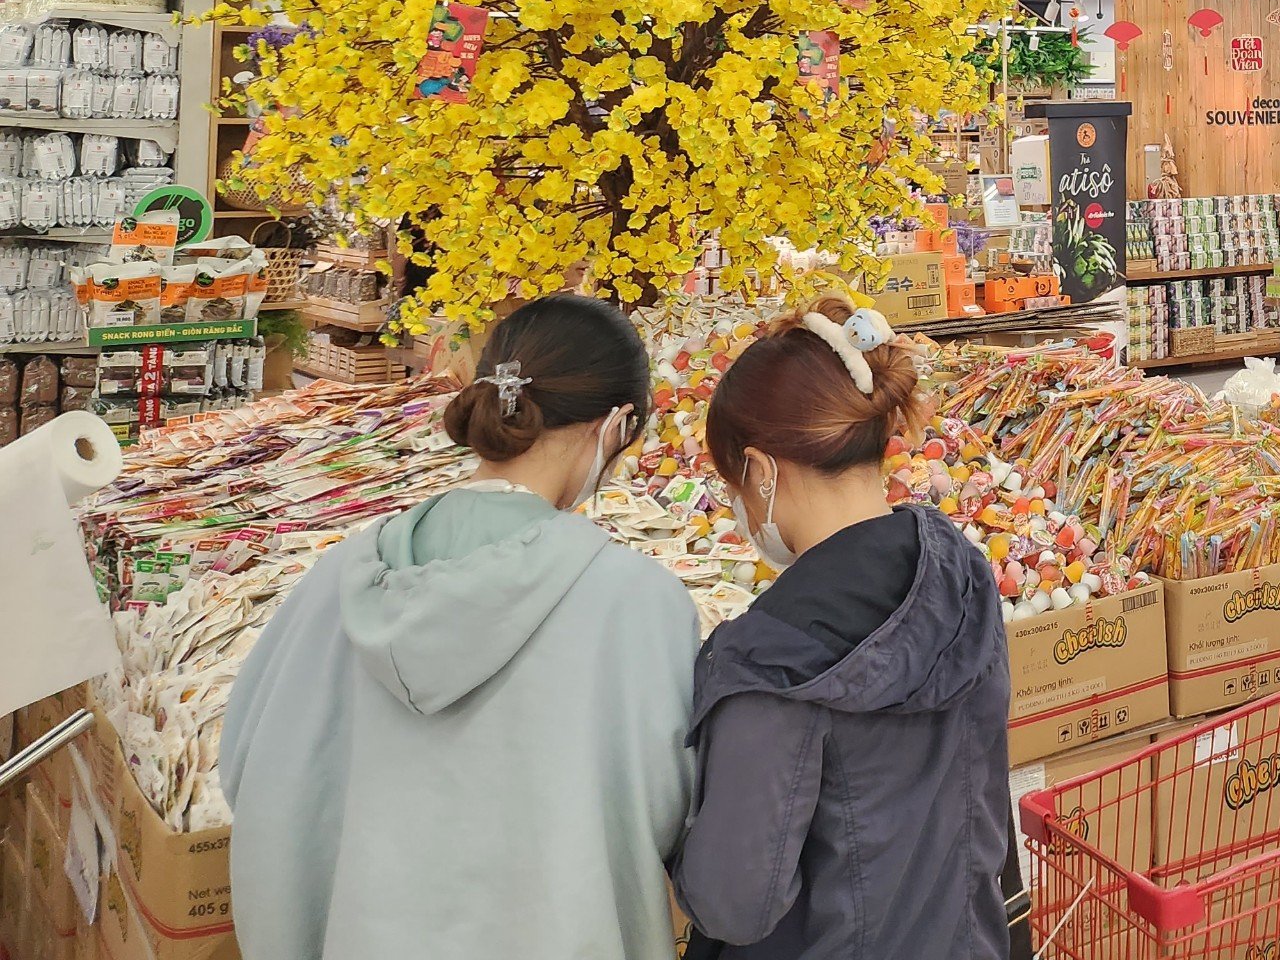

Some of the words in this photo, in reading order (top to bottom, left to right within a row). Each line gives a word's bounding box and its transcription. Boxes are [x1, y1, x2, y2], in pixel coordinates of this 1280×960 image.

[1237, 37, 1257, 50] Tết
[1058, 164, 1115, 199] atisô
[102, 331, 131, 341] SNACK
[132, 330, 154, 339] RONG
[155, 328, 176, 338] BIỂN
[203, 326, 226, 335] RĂNG
[226, 325, 243, 334] RẮC
[1189, 582, 1229, 596] 430x300x215
[1015, 622, 1059, 639] 430x300x215
[1054, 616, 1127, 664] cherish
[188, 887, 211, 901] Net
[188, 902, 215, 918] 405
[219, 901, 230, 916] g
